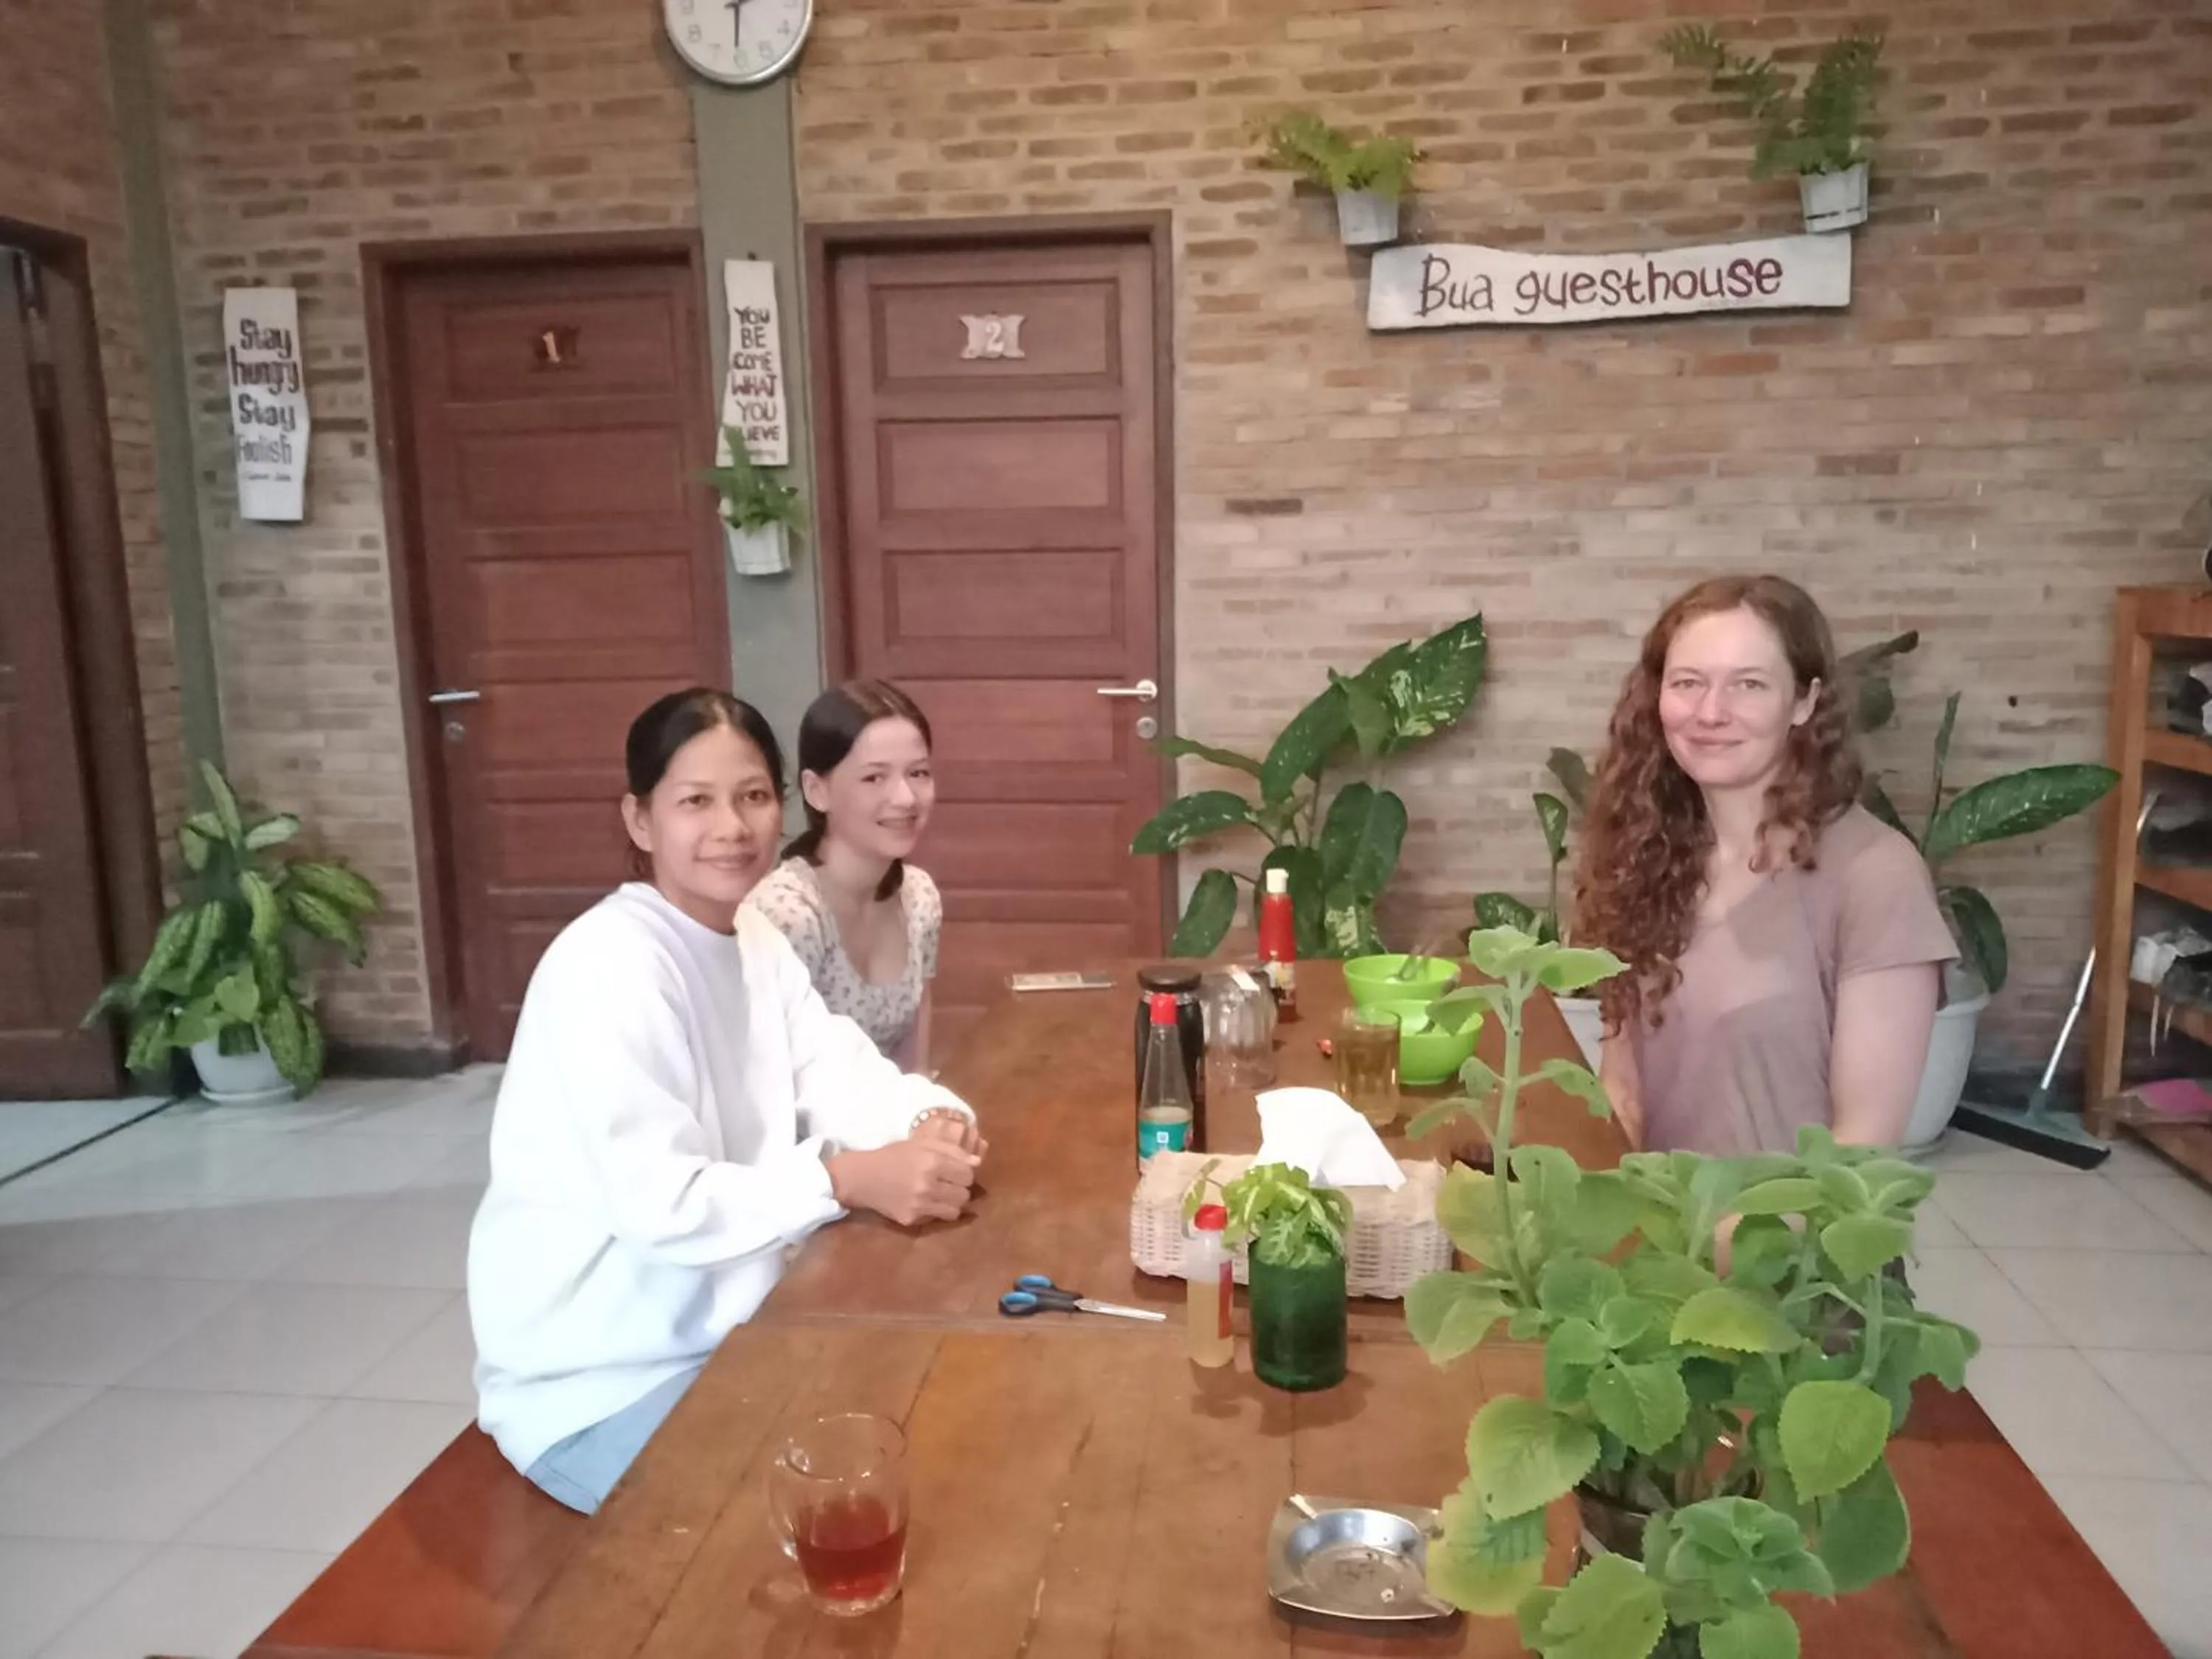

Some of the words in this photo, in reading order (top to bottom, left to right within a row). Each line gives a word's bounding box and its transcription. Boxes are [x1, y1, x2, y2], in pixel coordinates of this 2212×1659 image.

[1416, 253, 1494, 318] Bua
[1513, 257, 1783, 317] guesthouse
[733, 306, 771, 325] YOU
[240, 318, 292, 359] Stay
[740, 327, 767, 349] BE
[986, 321, 1004, 352] 2
[731, 373, 777, 397] WHAT
[238, 392, 296, 432] Stay
[735, 400, 777, 423] YOU
